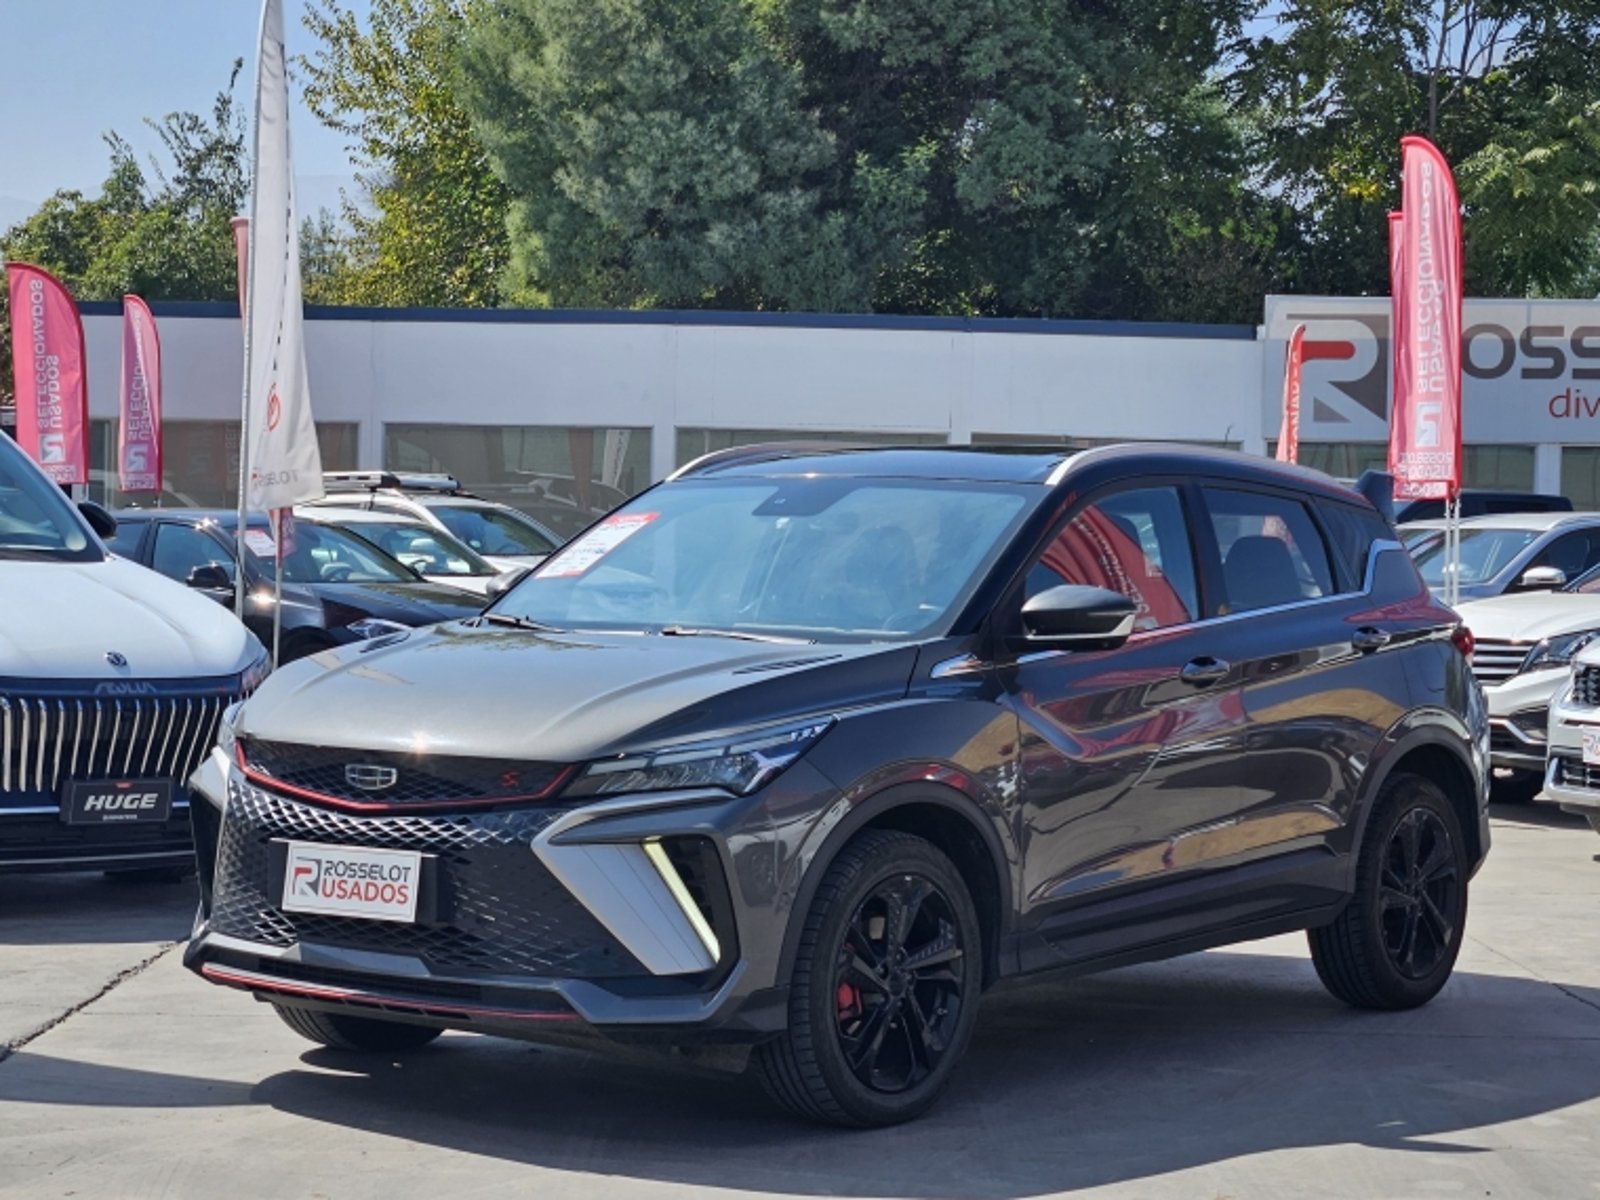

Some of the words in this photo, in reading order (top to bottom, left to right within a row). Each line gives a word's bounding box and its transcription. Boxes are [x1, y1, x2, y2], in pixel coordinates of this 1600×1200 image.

[84, 793, 158, 811] HUGE
[323, 860, 411, 883] ROSSELOT
[321, 878, 409, 904] USADOS
